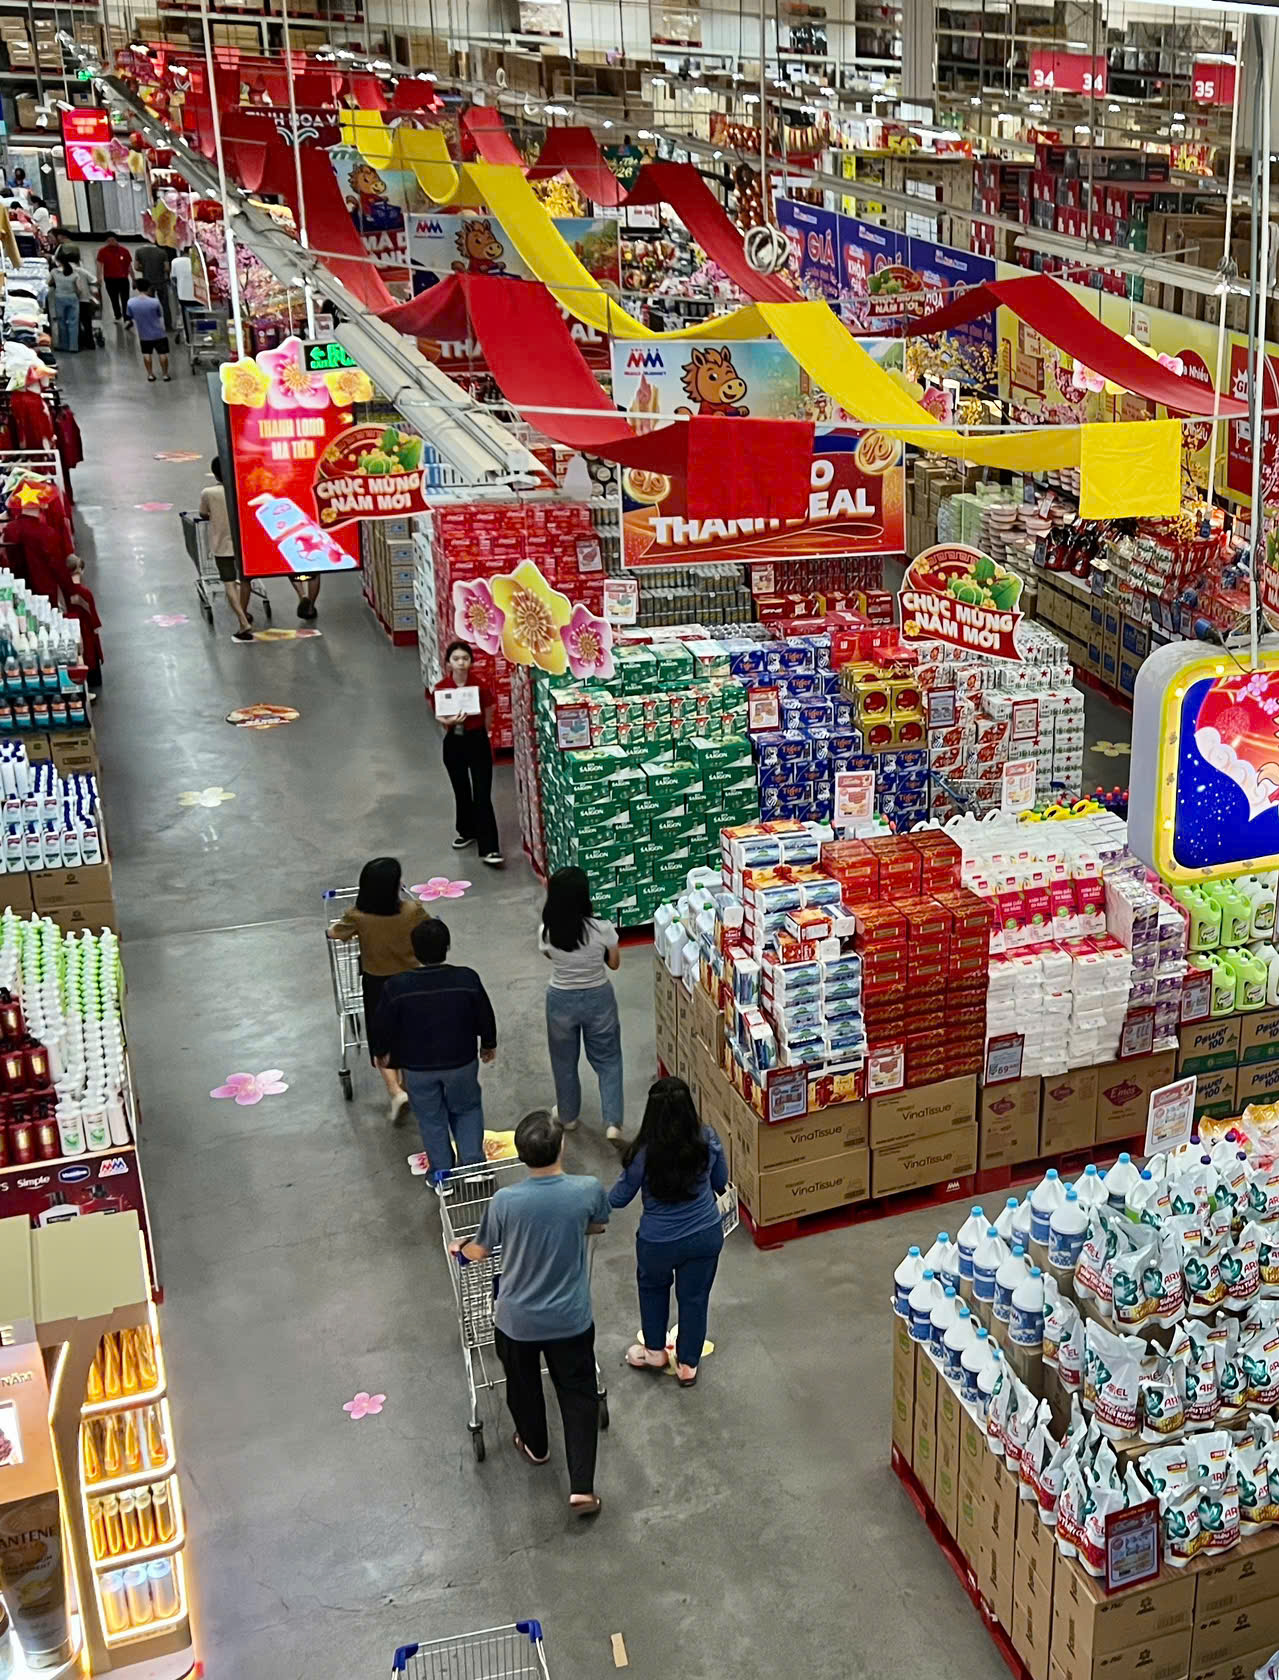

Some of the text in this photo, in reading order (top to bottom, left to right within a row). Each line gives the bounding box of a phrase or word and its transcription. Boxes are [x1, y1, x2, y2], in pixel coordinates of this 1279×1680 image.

[1034, 69, 1054, 88] 34
[1083, 73, 1103, 92] 34
[1195, 80, 1215, 98] 35
[316, 470, 420, 500] CHÚC MỪNG
[330, 491, 413, 513] NĂM MỚI
[902, 591, 1013, 634] CHÚC MỪNG
[914, 611, 1001, 650] NĂM MỚI
[1194, 1025, 1229, 1048] Power
[1264, 1074, 1279, 1088] 100
[1204, 1085, 1220, 1100] 100
[901, 1103, 953, 1122] VinaTissue
[790, 1125, 843, 1145] VinaTissue
[903, 1152, 953, 1170] VinaTissue
[17, 1176, 50, 1188] Simple
[791, 1177, 844, 1197] VinaTissue
[0, 1526, 56, 1549] ANTENE
